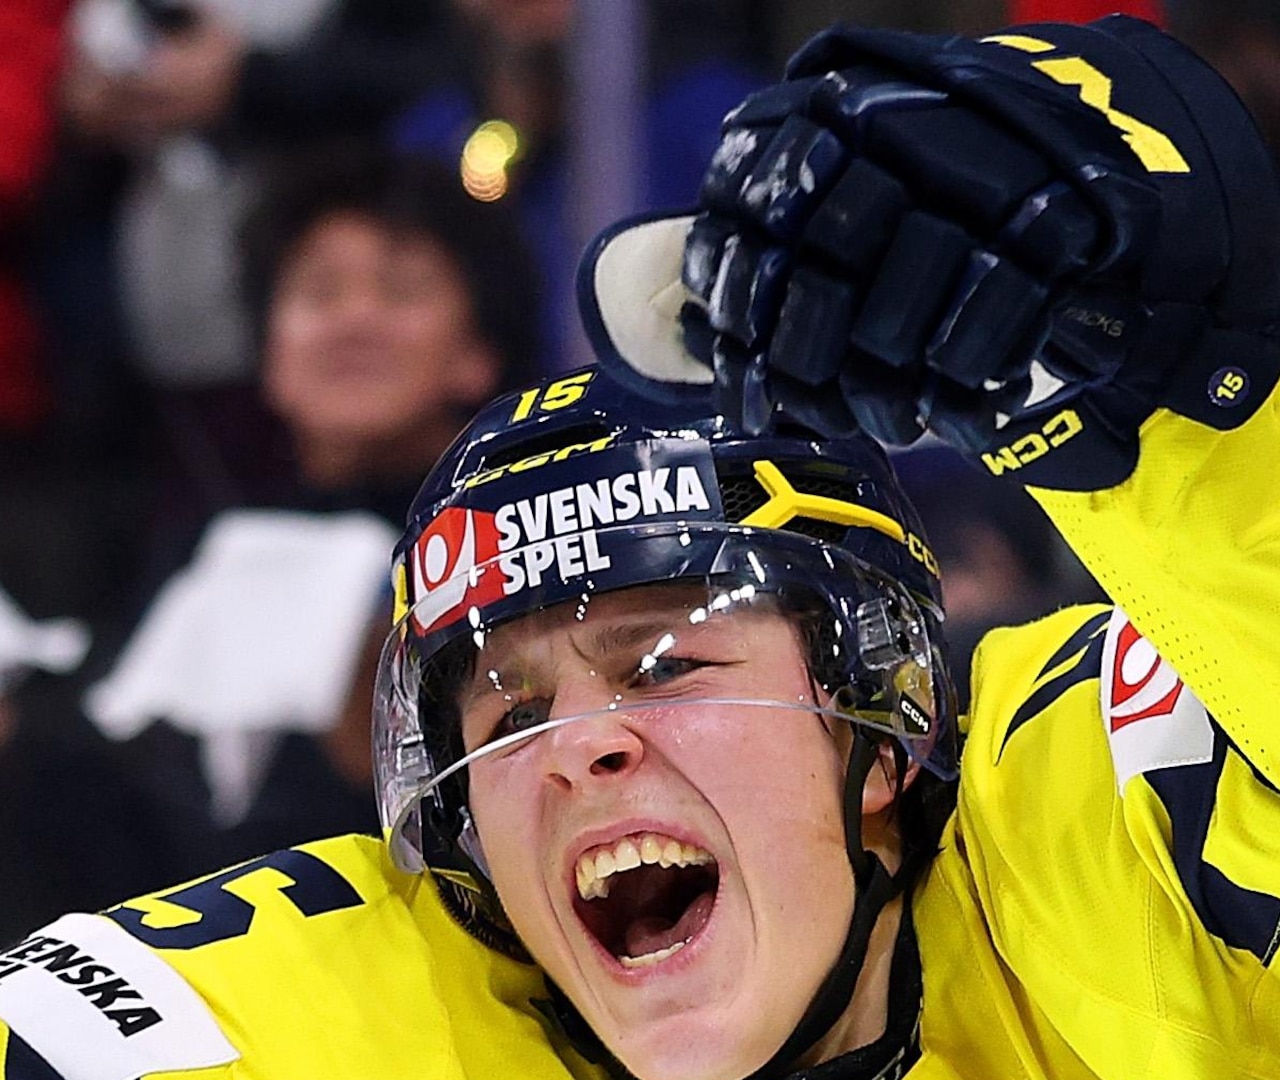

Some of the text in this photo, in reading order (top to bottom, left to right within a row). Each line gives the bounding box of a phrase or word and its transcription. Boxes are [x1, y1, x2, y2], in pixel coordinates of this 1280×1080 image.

[511, 371, 594, 423] 15
[1216, 371, 1245, 401] 15
[463, 436, 615, 488] CCM
[980, 409, 1084, 476] CCM
[493, 466, 710, 550] SVENSKA
[503, 529, 612, 596] SPEL
[907, 531, 941, 580] CC
